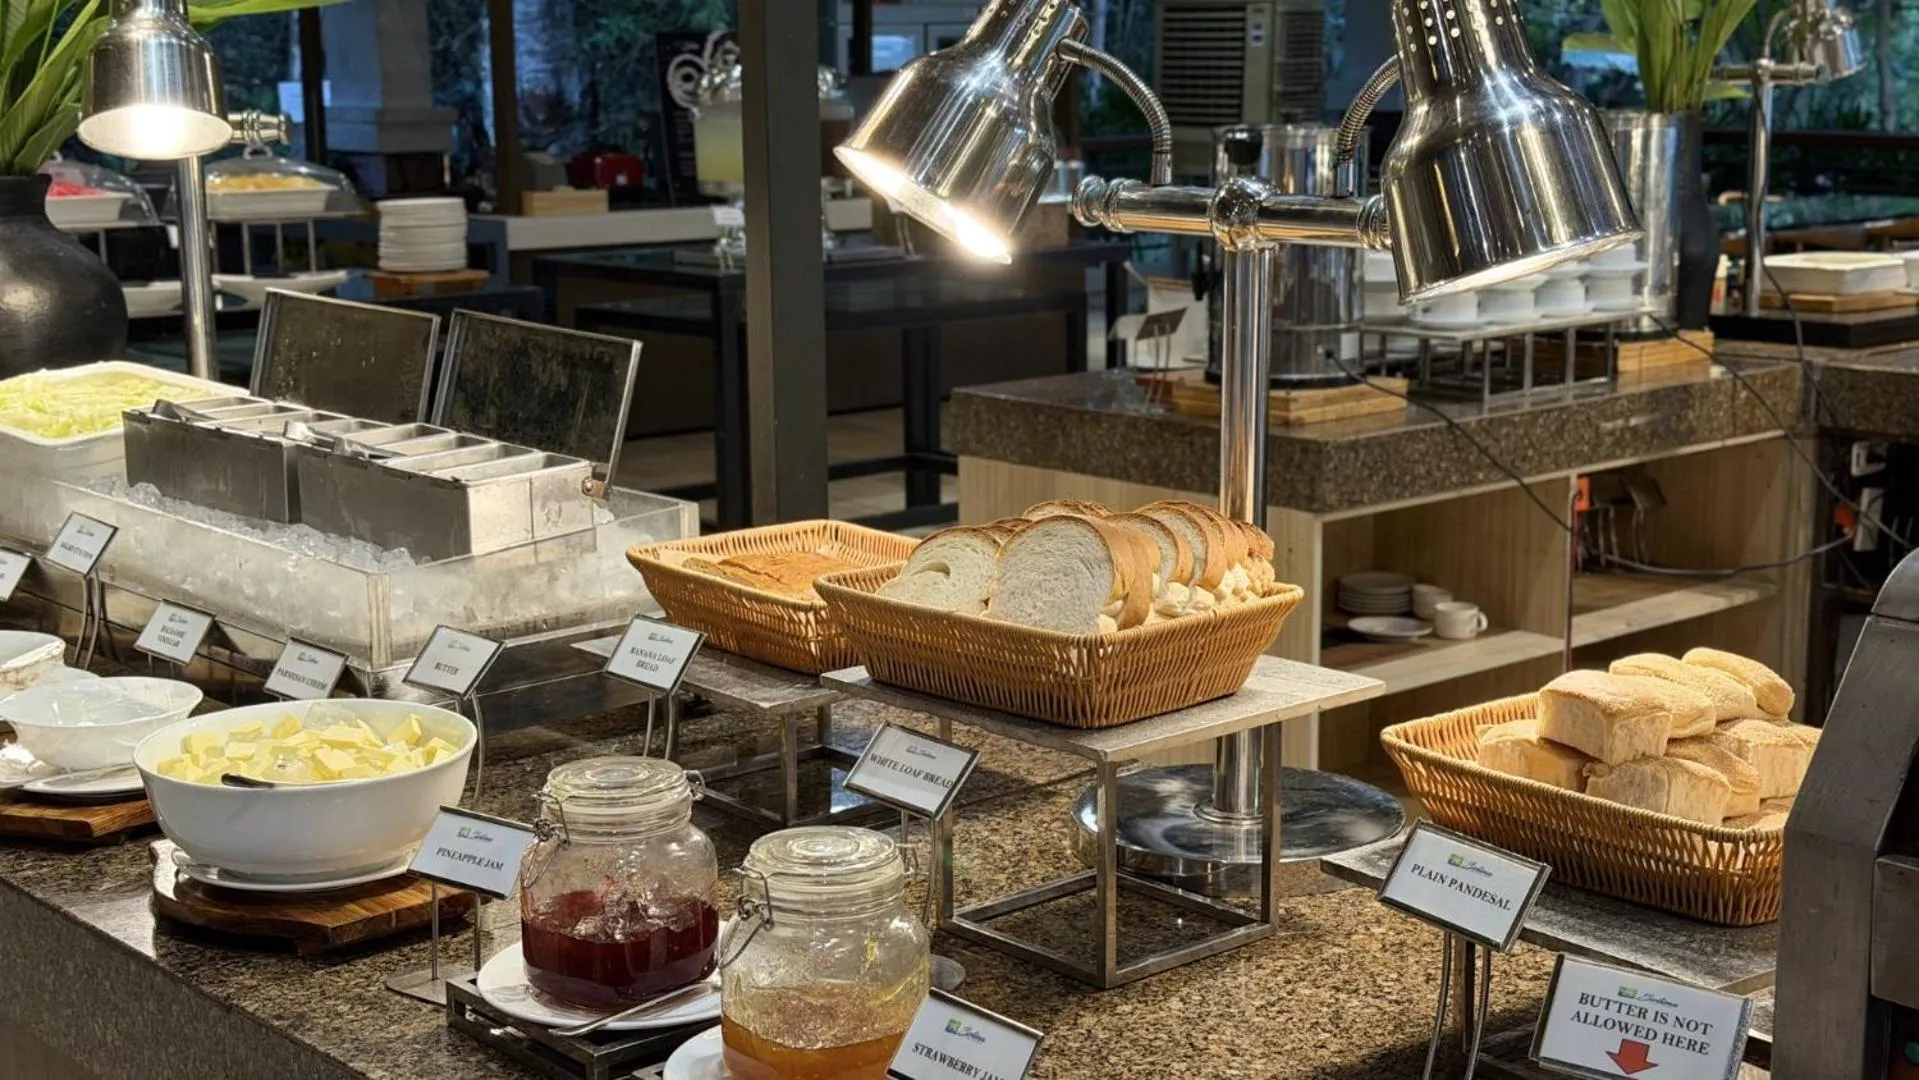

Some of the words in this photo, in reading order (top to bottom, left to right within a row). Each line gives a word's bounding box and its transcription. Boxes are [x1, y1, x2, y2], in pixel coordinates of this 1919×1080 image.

[434, 662, 459, 676] BUTTER
[630, 646, 658, 661] BANANA
[657, 653, 677, 665] LOAF
[635, 659, 660, 672] BREAD
[870, 754, 899, 773] WHITE
[899, 763, 924, 778] LOAF
[923, 771, 954, 789] BREAD
[436, 847, 485, 867] PINEAPPLE
[484, 860, 504, 871] JAM
[1410, 863, 1449, 885] PLAIN
[1448, 877, 1511, 910] PANDESAL
[1578, 992, 1649, 1021] BUTTER
[1652, 1010, 1669, 1025] IS
[1673, 1015, 1714, 1035] NOT
[1570, 1010, 1657, 1041] ALLOWED
[1661, 1031, 1711, 1055] HERE
[912, 1042, 982, 1078] STRAWBERRY
